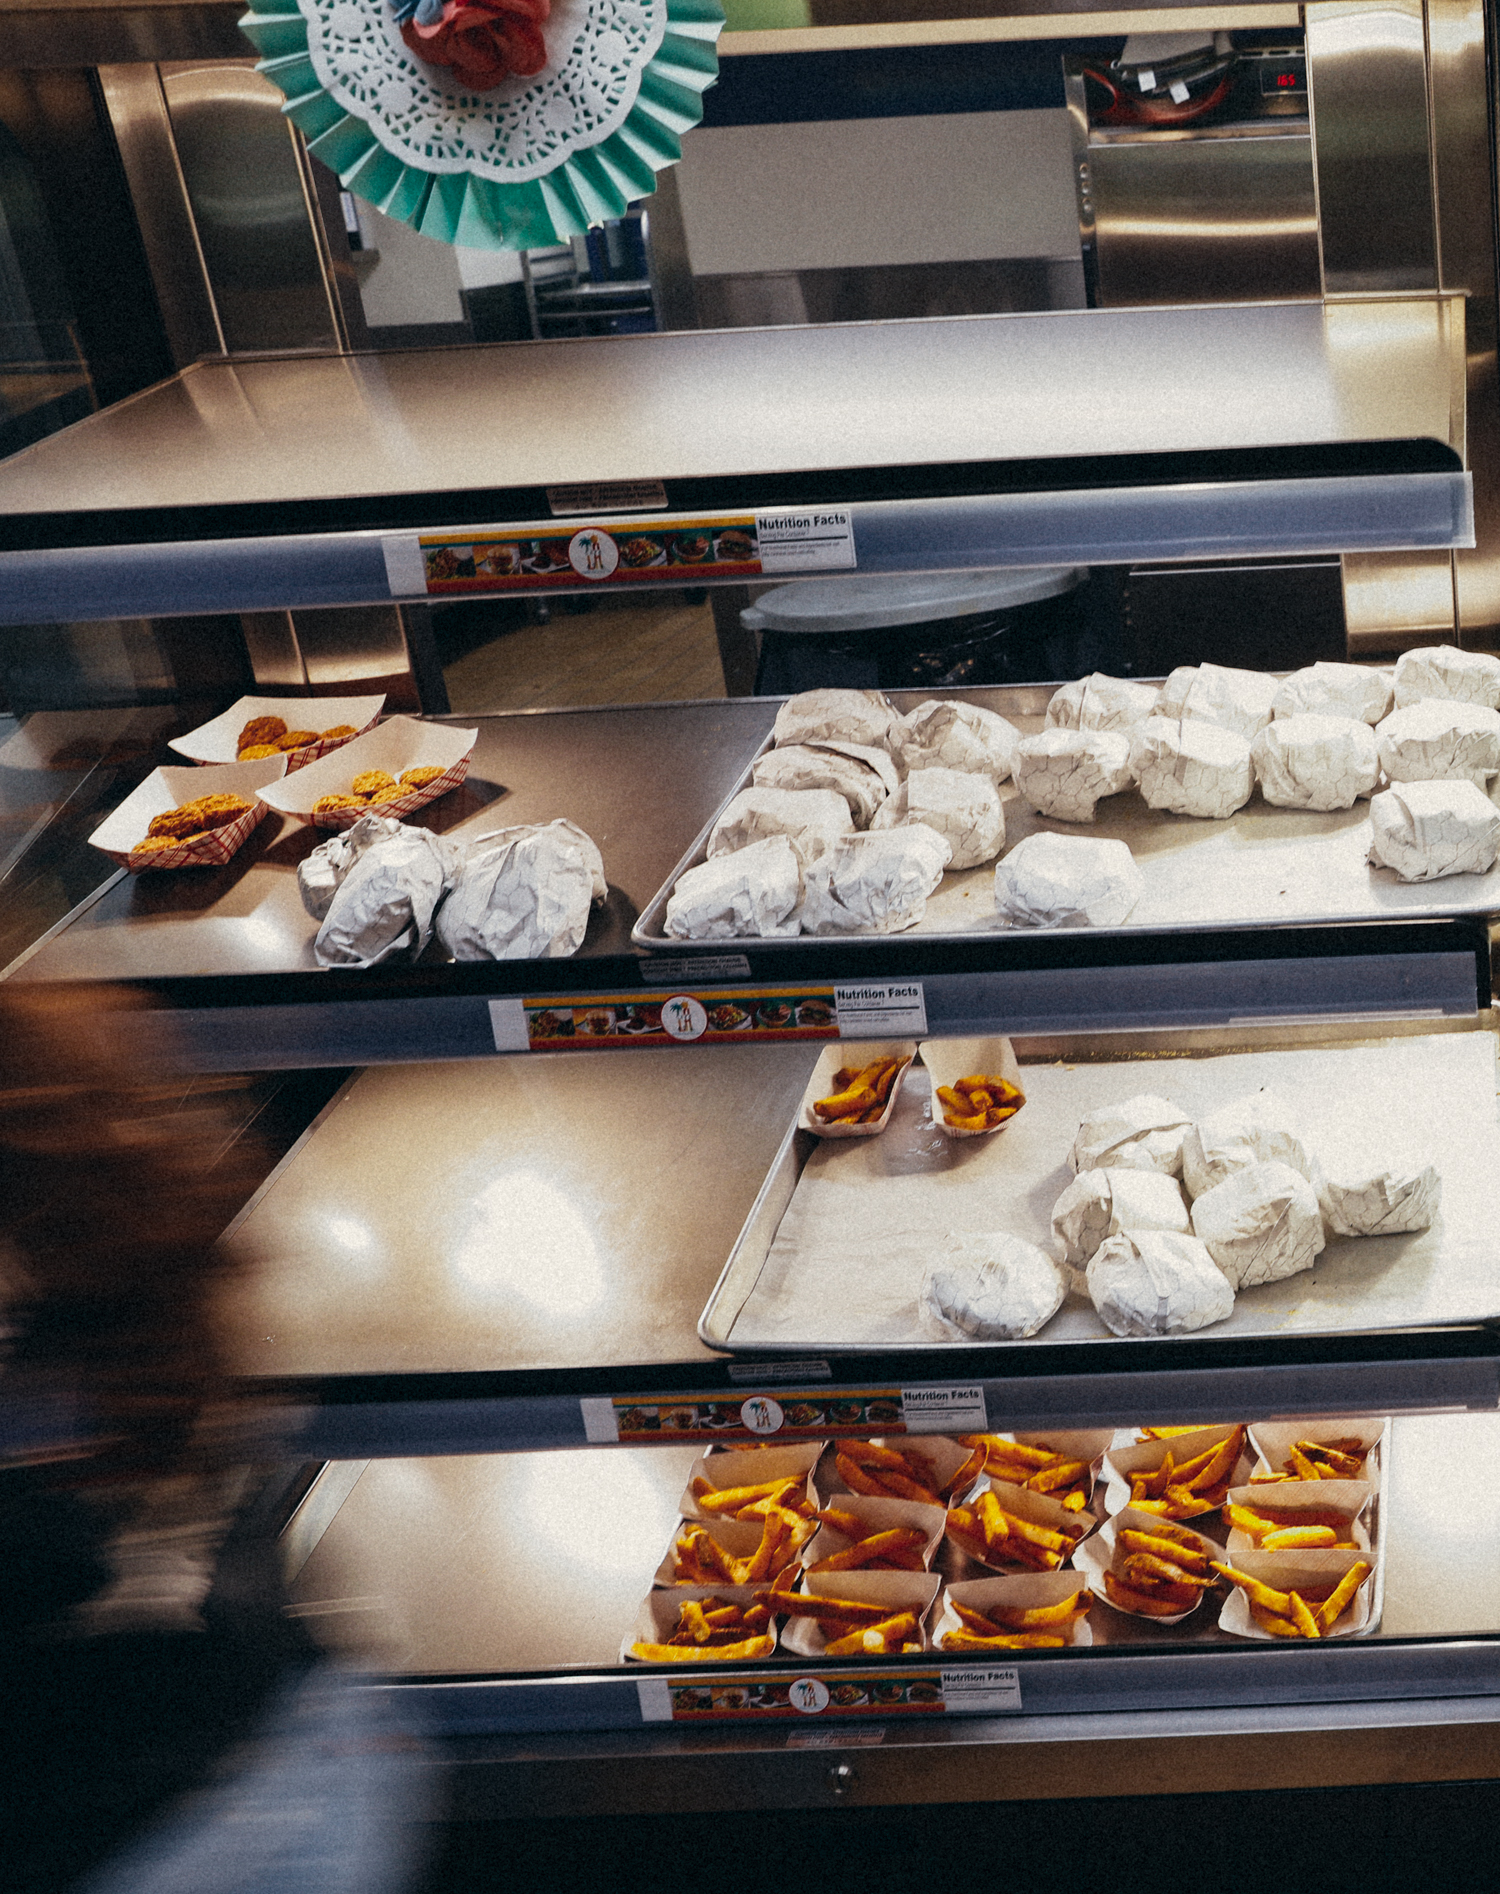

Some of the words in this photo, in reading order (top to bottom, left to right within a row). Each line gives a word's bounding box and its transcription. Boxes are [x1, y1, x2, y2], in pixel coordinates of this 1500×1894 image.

[758, 517, 811, 530] Nutrition
[814, 513, 847, 527] Facts
[837, 988, 885, 1000] Nutrition
[888, 986, 919, 998] Facts
[904, 1391, 949, 1401] Nutrition
[951, 1389, 980, 1399] Facts
[943, 1672, 985, 1682] Nutrition
[988, 1671, 1014, 1680] Facts
